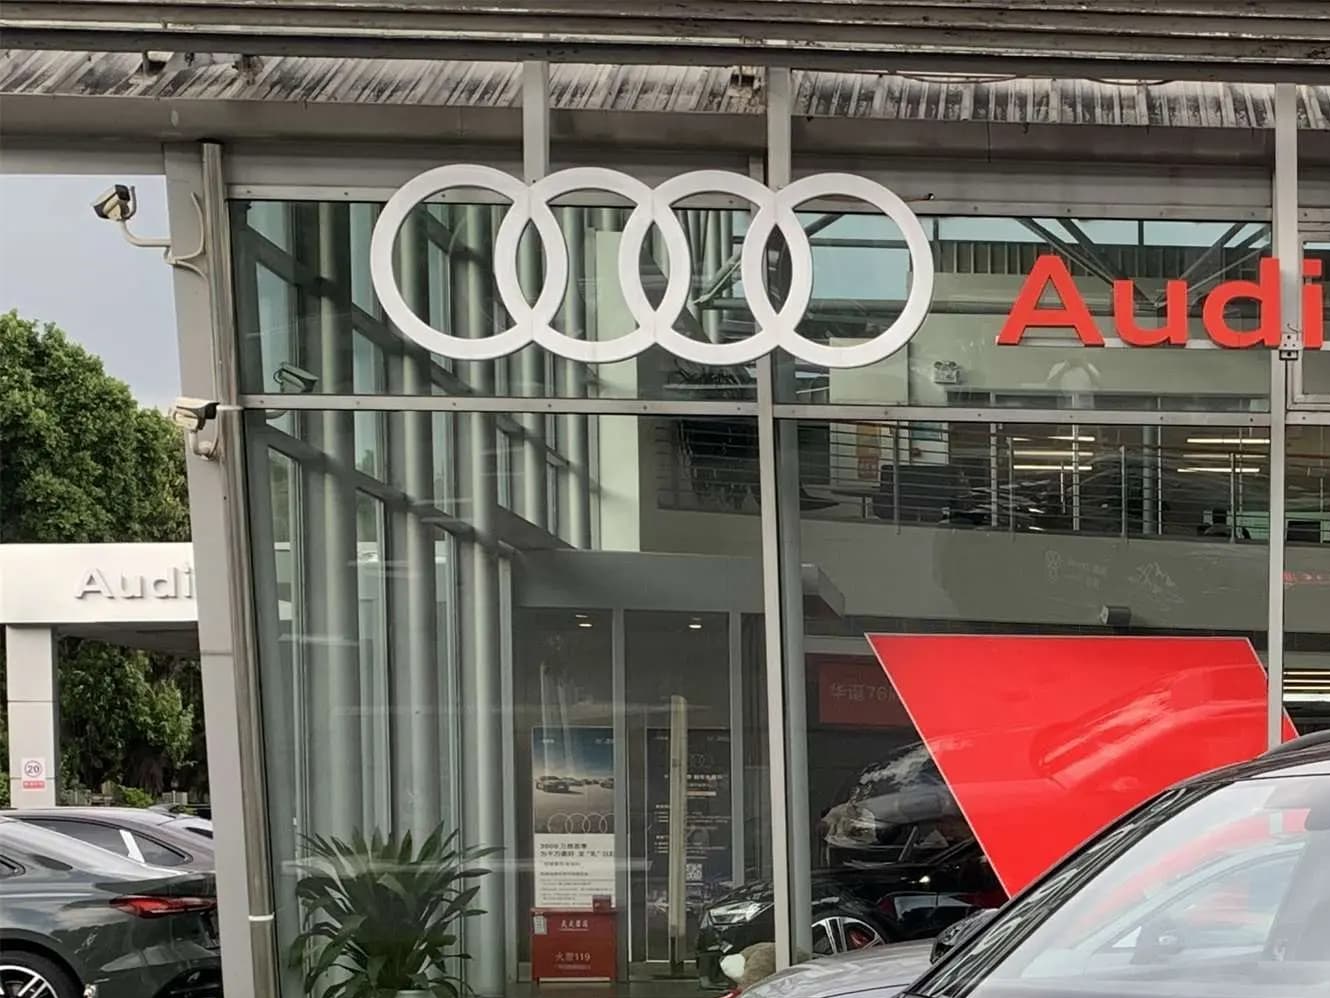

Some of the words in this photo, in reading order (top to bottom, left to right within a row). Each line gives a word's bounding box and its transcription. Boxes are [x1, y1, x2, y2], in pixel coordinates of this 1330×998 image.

[995, 253, 1325, 348] Audi
[74, 562, 194, 601] Audi
[27, 764, 40, 774] 20
